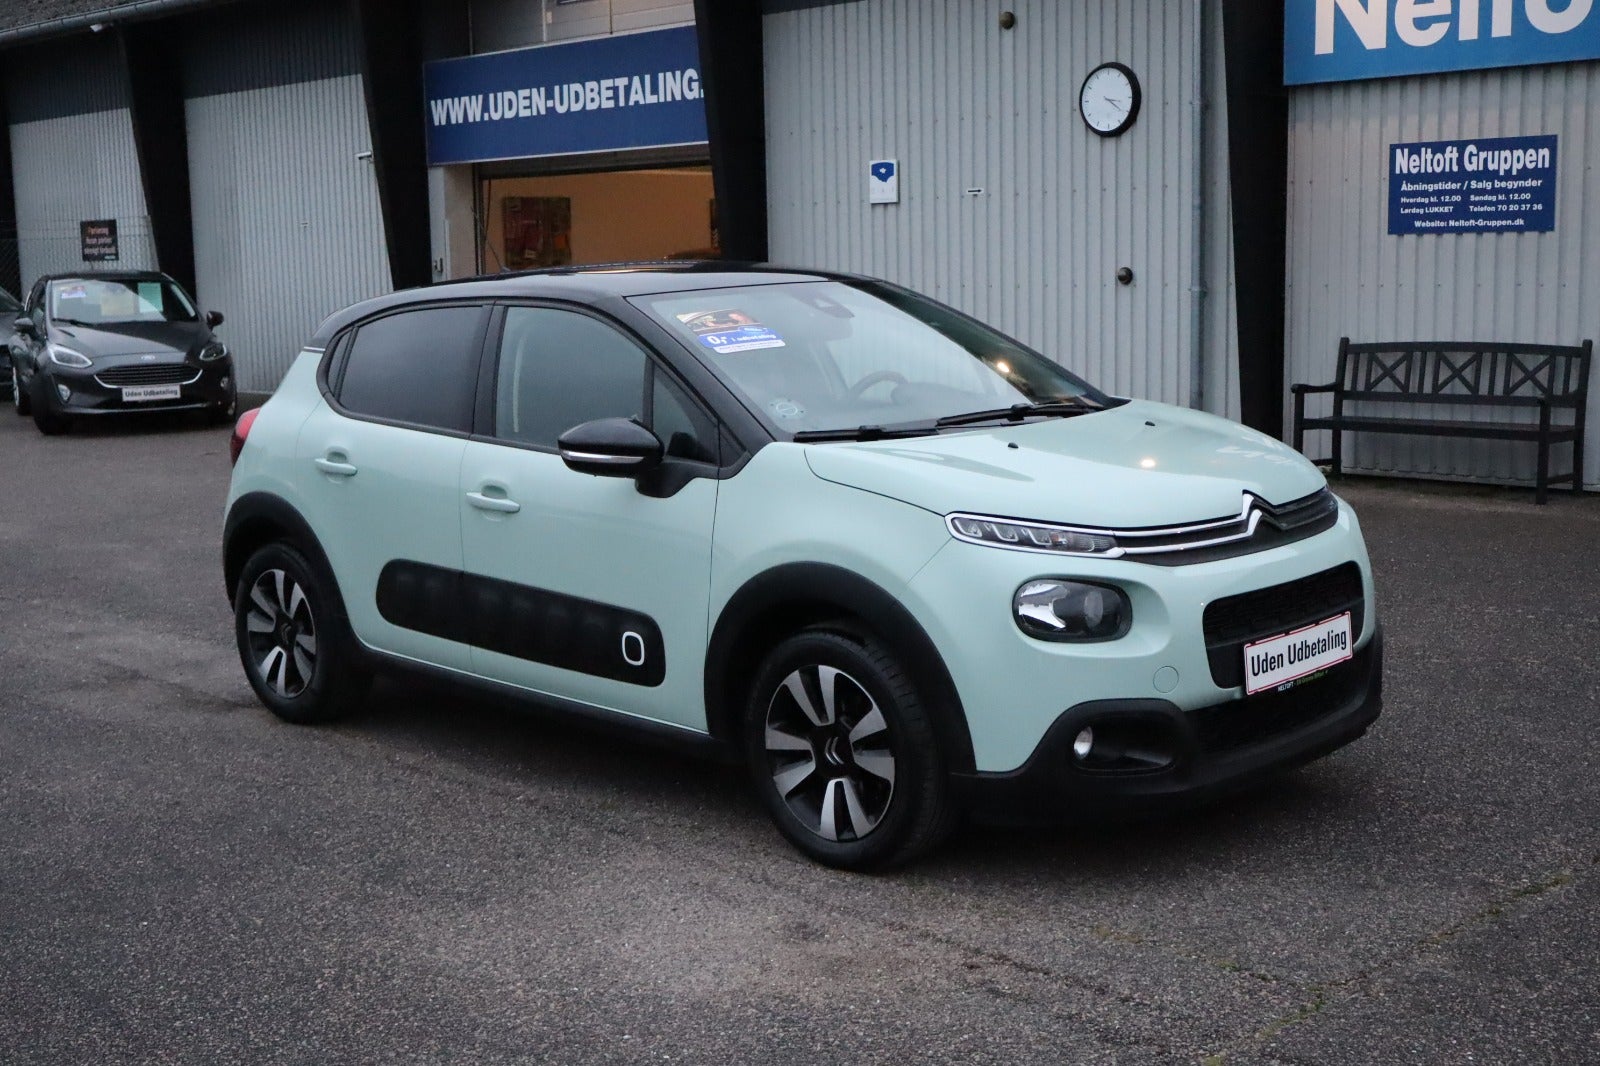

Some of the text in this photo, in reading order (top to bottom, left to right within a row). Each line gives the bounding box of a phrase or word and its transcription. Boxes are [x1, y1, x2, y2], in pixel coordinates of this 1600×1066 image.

[1395, 144, 1550, 176] Neltoft Gruppen
[1401, 180, 1461, 192] Åbningstider
[1470, 180, 1492, 190] Salg
[1494, 178, 1543, 190] begynder
[1400, 196, 1429, 204] Hverdag
[1509, 192, 1531, 200] 12.00
[1497, 204, 1508, 212] 70
[1414, 218, 1525, 228] Website: Neltoft-Gruppen.dk
[143, 388, 178, 397] Udbetaling
[1251, 630, 1347, 677] Uden Udbetaling
